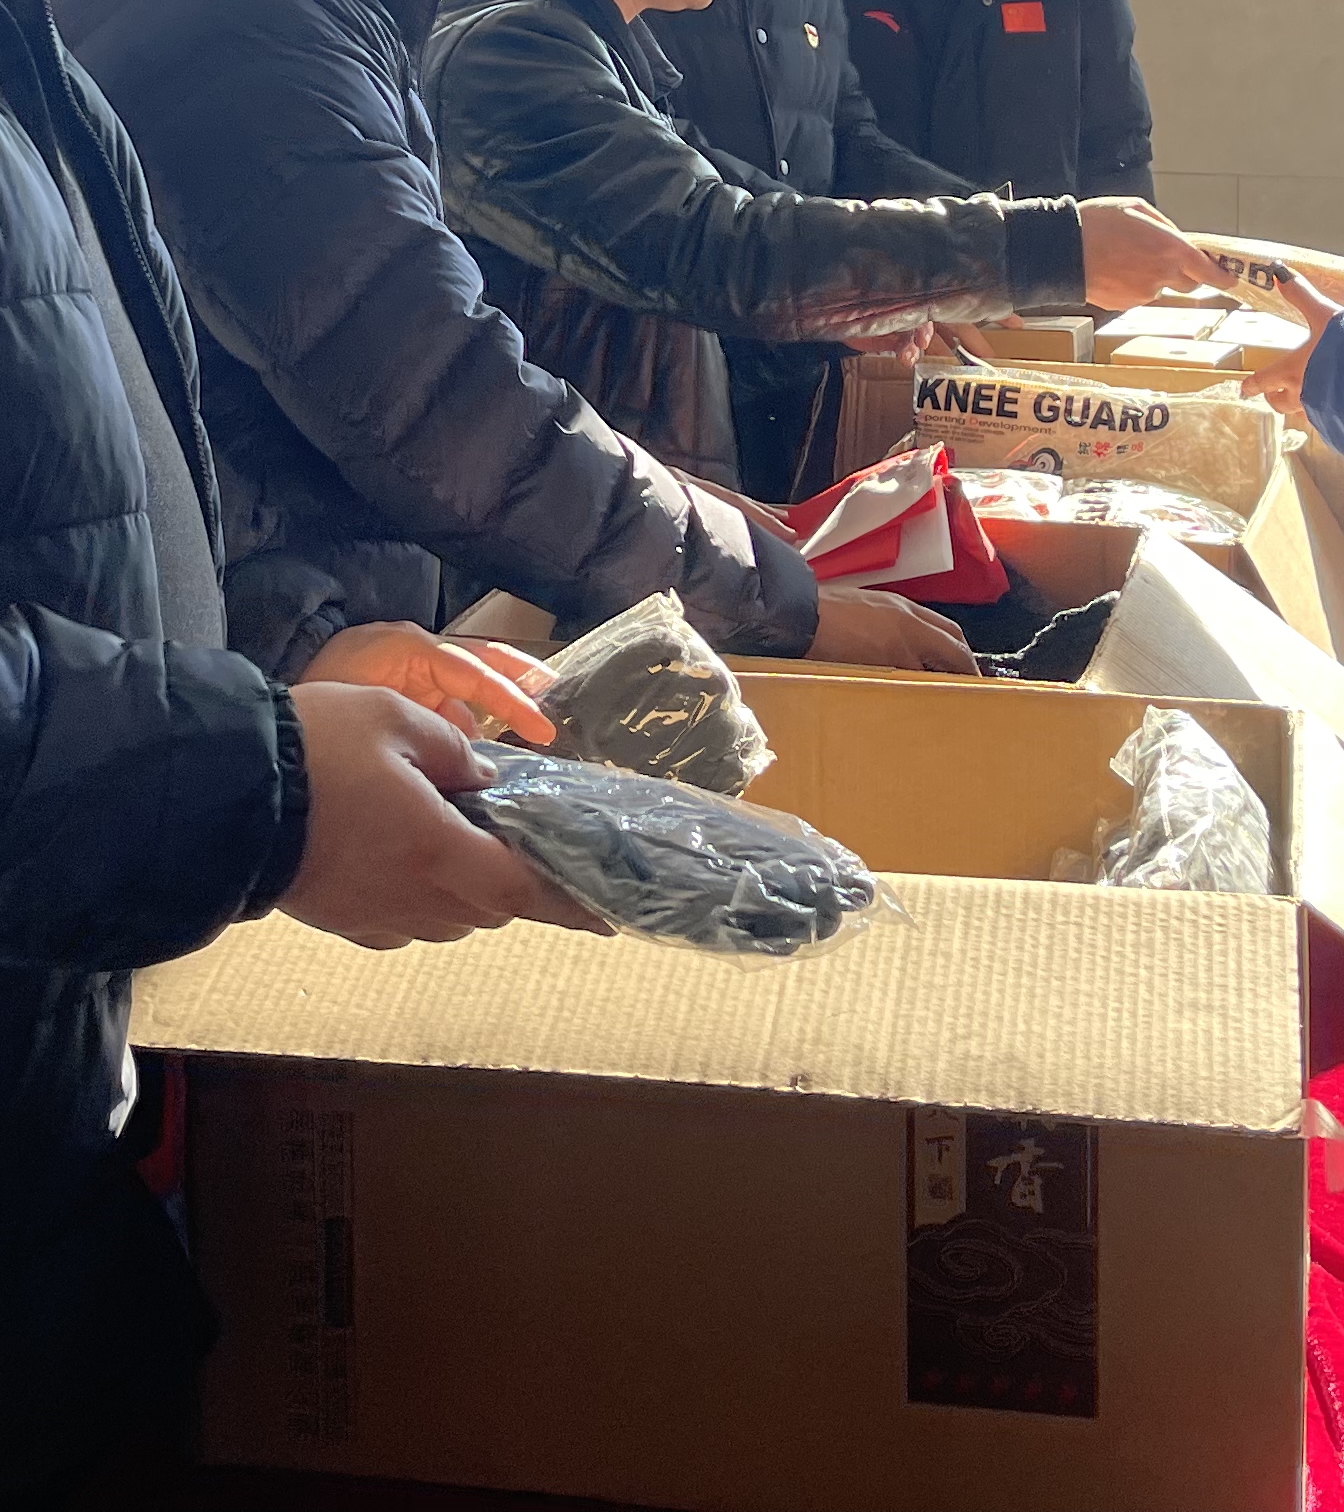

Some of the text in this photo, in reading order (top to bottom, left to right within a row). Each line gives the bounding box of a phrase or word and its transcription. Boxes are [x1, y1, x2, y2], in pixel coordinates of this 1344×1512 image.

[916, 377, 1021, 419] KNEE
[1032, 391, 1170, 433] GUARD
[969, 417, 1052, 435] Development
[980, 1116, 1065, 1215] 香
